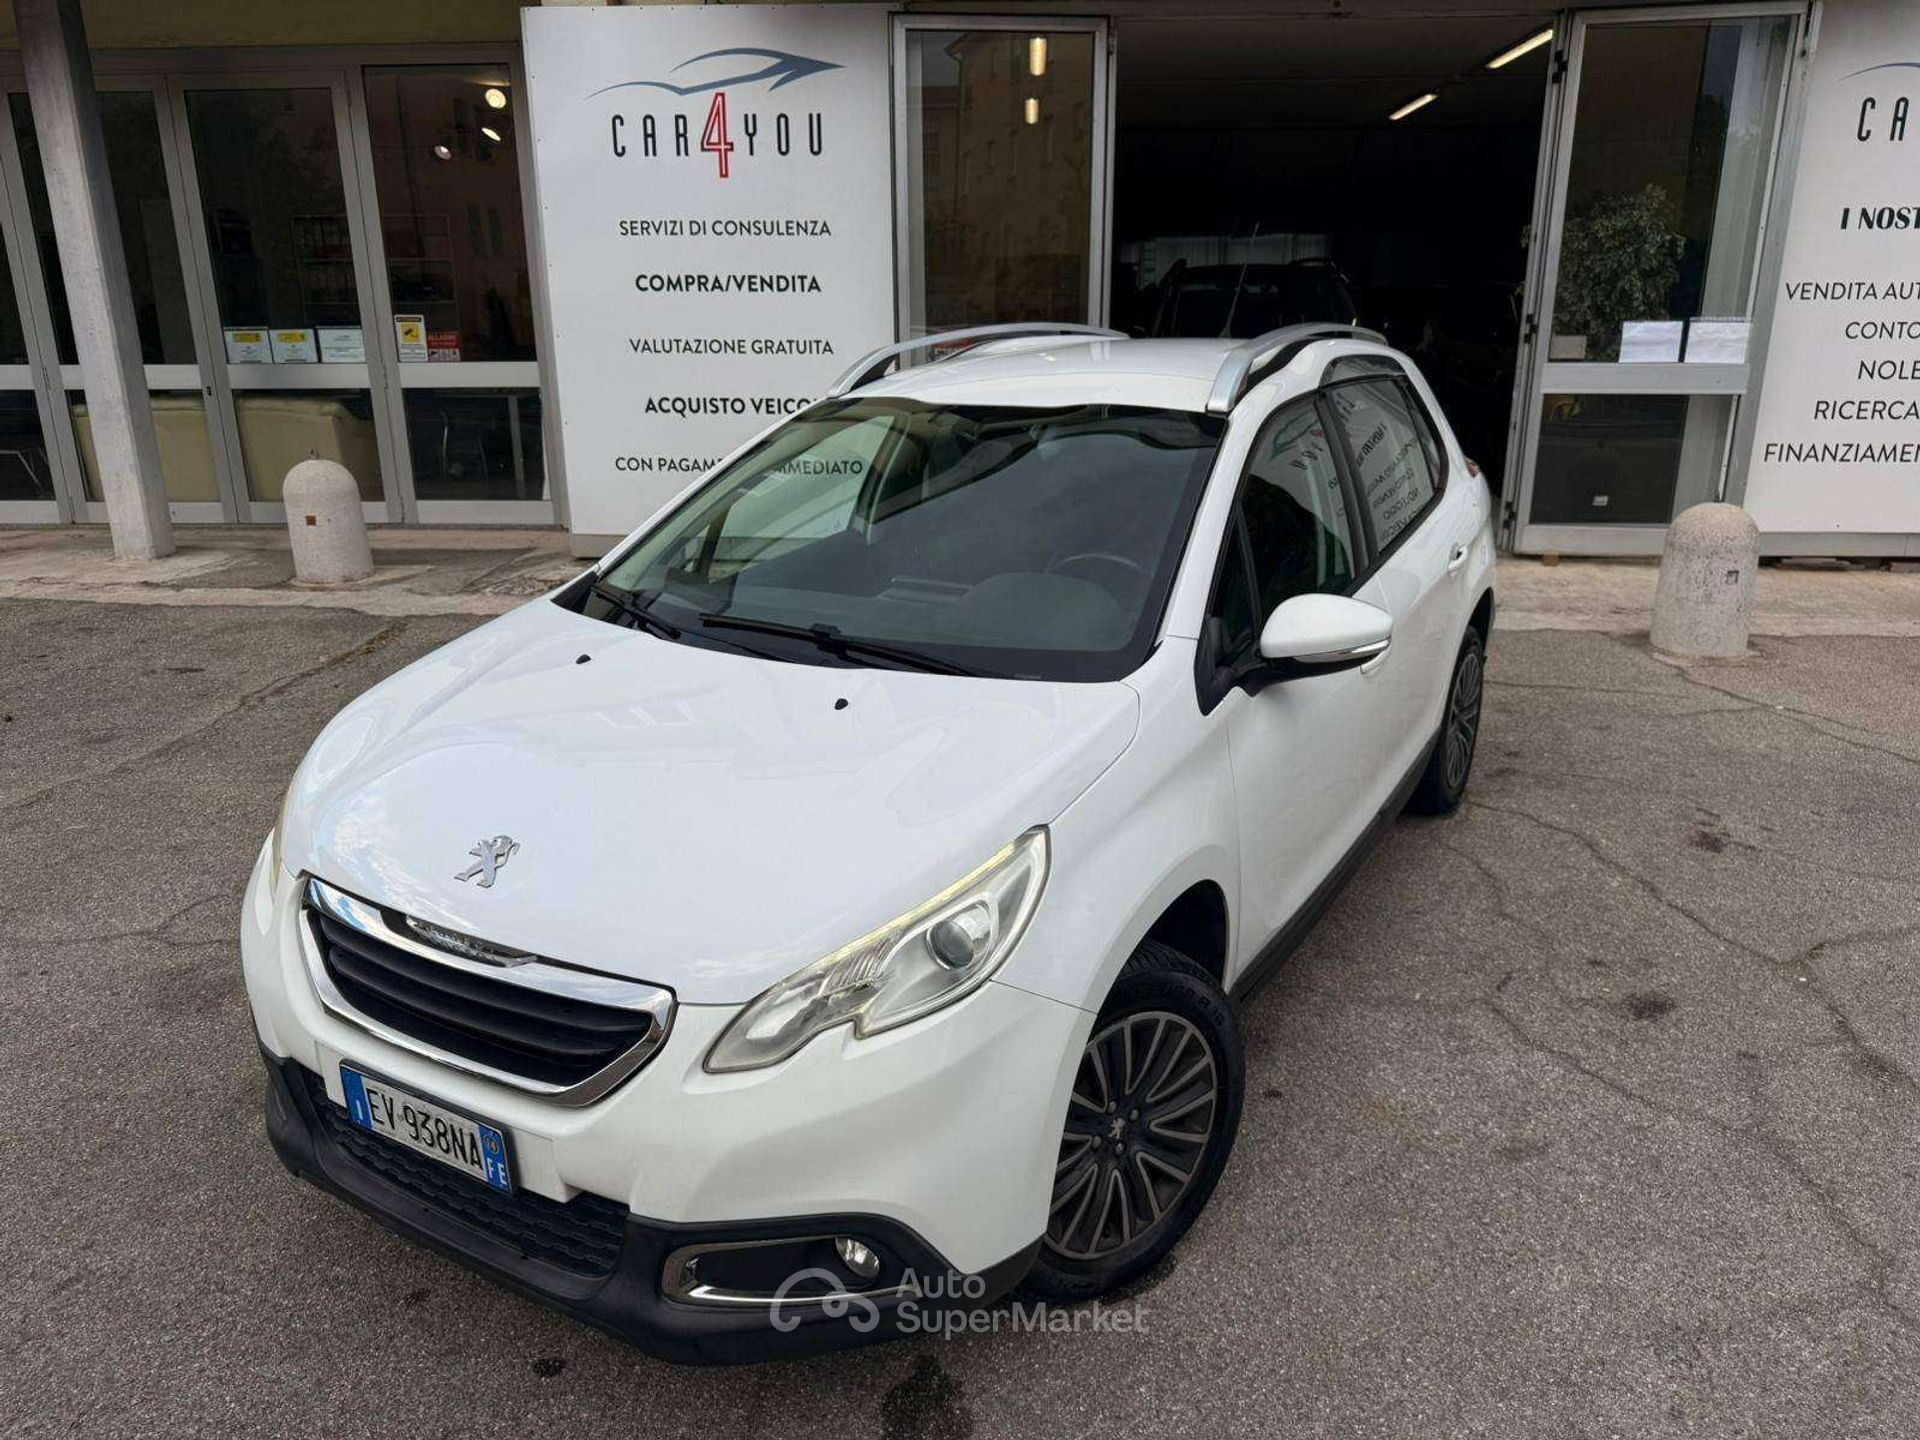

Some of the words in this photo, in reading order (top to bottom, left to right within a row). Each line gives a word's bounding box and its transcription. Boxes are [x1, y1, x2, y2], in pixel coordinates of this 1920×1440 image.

[619, 219, 684, 237] SERVIZI
[688, 220, 707, 236] DI
[711, 219, 832, 237] CONSULENZA
[1840, 207, 1851, 230] I
[635, 274, 822, 293] COMPRA/VENDITA
[1785, 281, 1878, 301] VENDITA
[1845, 321, 1920, 340] CONTO
[629, 338, 747, 355] VALUTAZIONE
[751, 338, 834, 355] GRATUITA
[1857, 359, 1920, 380] NOLE
[644, 396, 746, 419] ACQUISTO
[750, 396, 817, 415] VEICO
[1813, 400, 1920, 420] RICERCA
[615, 456, 653, 472] CON
[658, 457, 723, 473] PAGAM
[776, 460, 863, 476] MMEDIATO
[366, 1088, 396, 1131] EV
[402, 1105, 484, 1171] 938NA
[487, 1157, 508, 1186] FE
